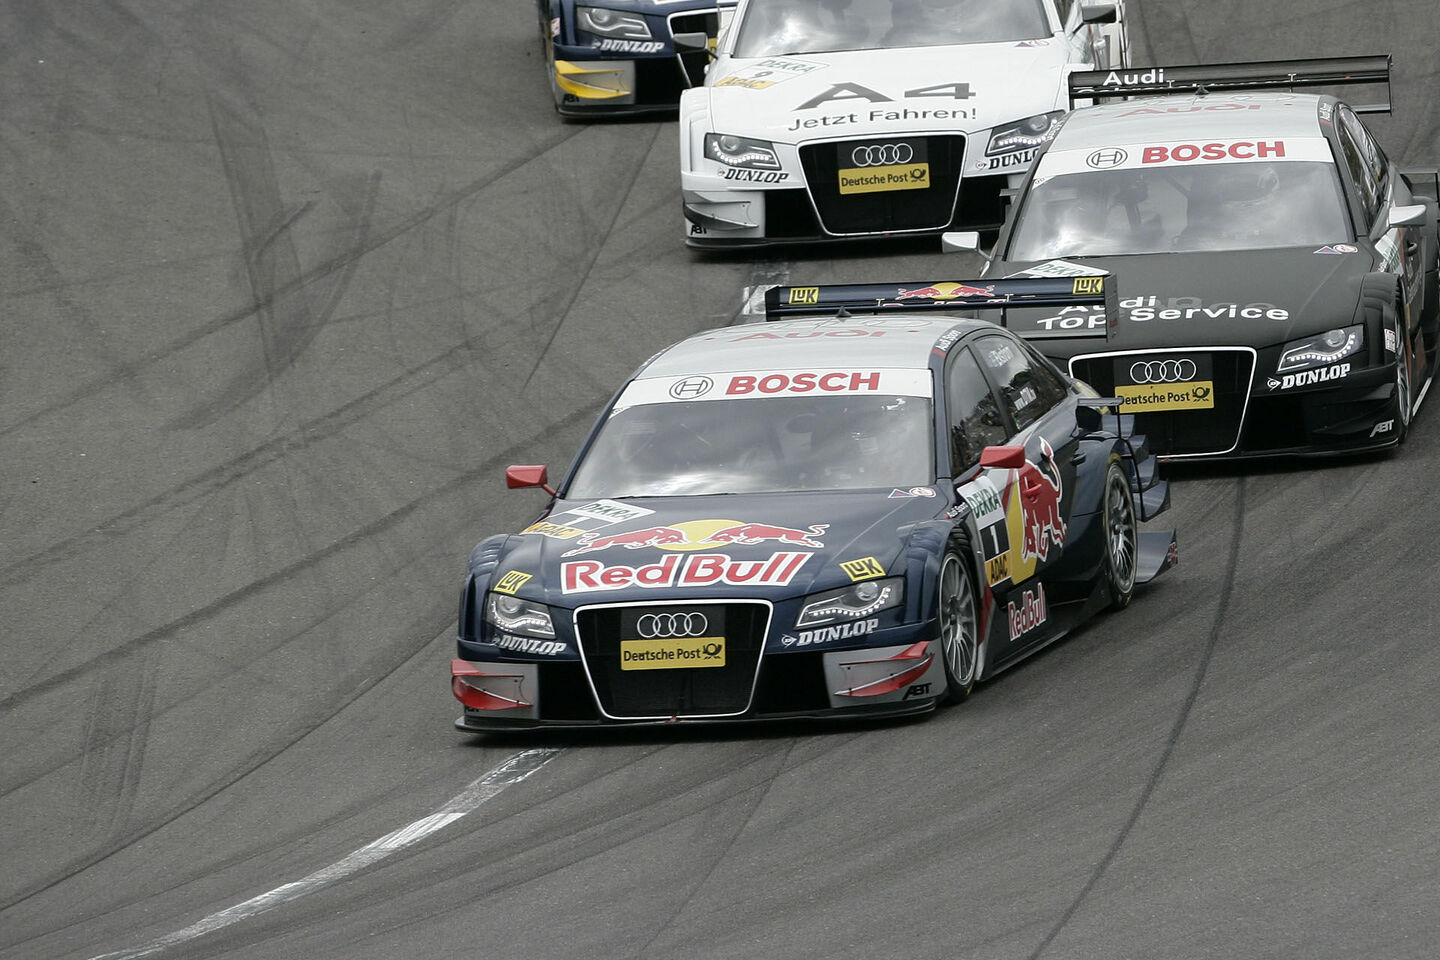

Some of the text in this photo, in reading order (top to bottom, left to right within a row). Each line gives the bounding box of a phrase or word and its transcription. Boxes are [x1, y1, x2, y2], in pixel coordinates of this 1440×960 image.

[601, 39, 665, 53] DUNLOP
[759, 59, 816, 73] DEKRA
[1102, 68, 1165, 86] Audi
[788, 107, 977, 132] Jetzt Fahren!
[988, 148, 1039, 170] DUNL
[1142, 141, 1286, 164] BOSCH
[724, 169, 790, 184] DUNLOP
[841, 173, 909, 188] Deutsche Post
[1033, 263, 1090, 277] DEKR
[1036, 313, 1107, 331] Top
[1129, 305, 1290, 322] Service
[725, 372, 881, 396] BOSCH
[1281, 363, 1351, 390] DUNLOP
[1117, 390, 1191, 406] Deutsche Post
[1369, 419, 1395, 438] ABT
[579, 502, 640, 521] DEKRA
[989, 524, 1000, 556] 1
[563, 552, 810, 592] Red Bull
[990, 555, 1008, 582] ADAC
[1008, 582, 1047, 641] Red Bull
[796, 618, 879, 647] DUNLOP
[499, 634, 567, 656] DUNLOP
[623, 647, 701, 662] Deutsche Post
[902, 682, 933, 701] ABT
